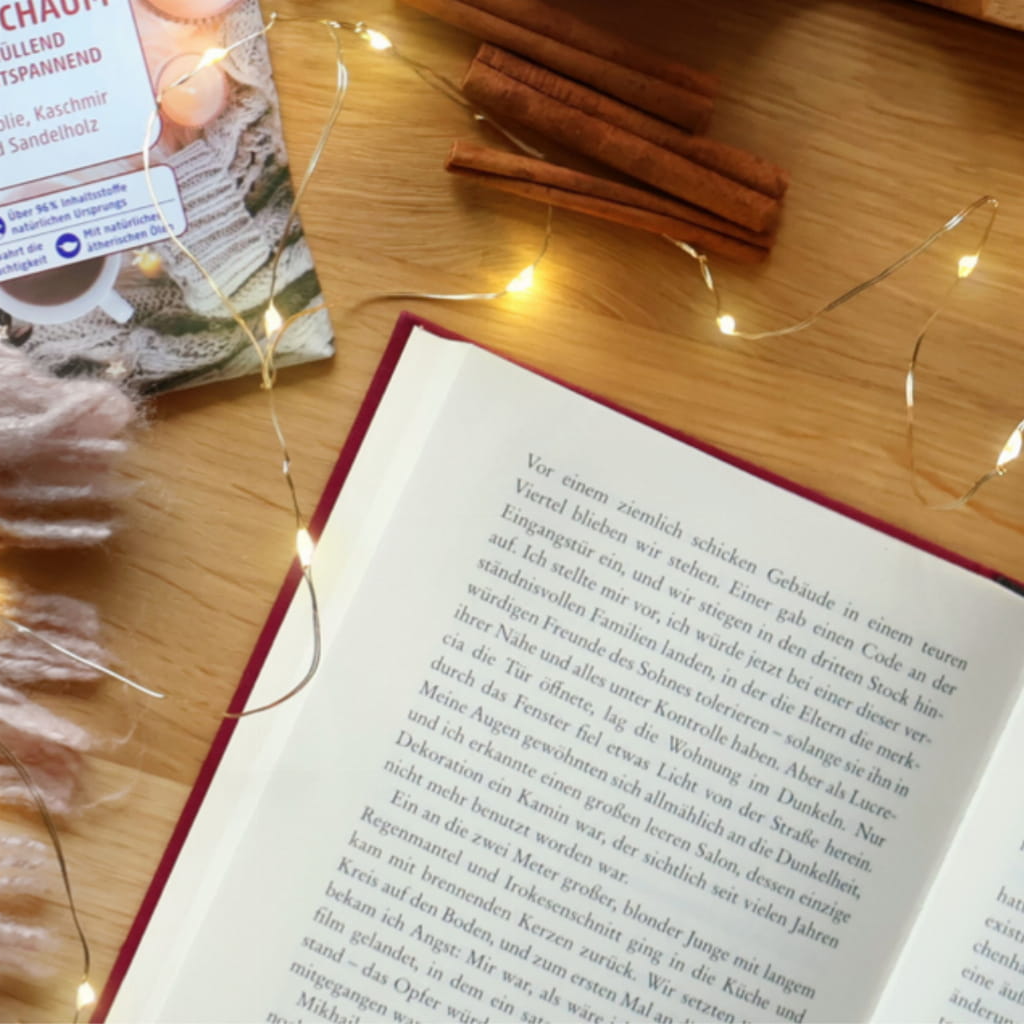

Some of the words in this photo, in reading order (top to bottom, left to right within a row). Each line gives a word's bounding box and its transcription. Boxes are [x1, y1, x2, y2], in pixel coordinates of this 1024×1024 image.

[9, 118, 100, 154] Sandelholz
[33, 90, 108, 121] Kaschmir
[8, 207, 34, 221] Über
[59, 183, 127, 207] Inhaltsstoffe
[11, 213, 72, 236] natürlichen
[73, 198, 128, 220] Ursprungs
[27, 241, 44, 255] die
[83, 226, 101, 239] Mit
[103, 213, 160, 233] natürliche
[87, 230, 148, 253] ätherischen
[487, 533, 518, 554] auf.
[521, 543, 547, 568] Ich
[550, 561, 597, 591] stellte
[599, 585, 630, 605] mir
[633, 600, 661, 624] vor,
[665, 611, 690, 635] ich
[695, 628, 745, 660] würde
[744, 649, 783, 679] jetzt
[785, 666, 813, 691] bei
[812, 684, 854, 710] einer
[854, 700, 901, 732] dieser
[904, 725, 931, 743] ver-
[500, 502, 595, 558] Eingangstür
[597, 552, 625, 577] ein,
[631, 569, 665, 591] und
[668, 585, 695, 606] wir
[697, 600, 753, 634] stiegen
[756, 623, 774, 644] in
[776, 634, 807, 659] den
[810, 649, 864, 685] dritten
[866, 675, 909, 706] Stock
[912, 694, 943, 719] hin-
[515, 477, 568, 515] Viertel
[570, 503, 628, 544] blieben
[635, 539, 663, 559] wir
[667, 555, 720, 589] stehen.
[727, 579, 773, 611] Einer
[775, 607, 807, 627] gab
[811, 621, 854, 651] einen
[860, 641, 903, 672] Code
[906, 667, 927, 683] an
[931, 673, 957, 696] der
[527, 451, 554, 478] Vor
[561, 473, 609, 504] einem
[616, 499, 683, 539] ziemlich
[689, 535, 757, 574] schicken
[765, 567, 836, 610] Gebäude
[842, 601, 859, 622] in
[866, 615, 913, 647] einem
[920, 641, 968, 671] teuren
[429, 655, 475, 687] durch
[480, 679, 507, 702] das
[512, 693, 571, 732] Fenster
[574, 722, 603, 747] fiel
[605, 743, 650, 770] etwas
[655, 761, 698, 793] Licht
[704, 787, 733, 810] von
[737, 800, 765, 824] der
[768, 814, 819, 849] Straße
[823, 837, 872, 872] herein.
[441, 632, 465, 652] cia
[470, 643, 496, 666] die
[504, 656, 533, 683] Tür
[538, 676, 595, 716] öffnete,
[602, 704, 627, 733] lag
[632, 721, 659, 744] die
[668, 734, 742, 786] Wohnung
[747, 773, 770, 796] im
[775, 786, 845, 831] Dunkeln.
[853, 821, 886, 847] Nur
[452, 603, 493, 633] ihrer
[494, 622, 538, 655] Nähe
[539, 648, 573, 671] und
[570, 662, 606, 688] alles
[608, 681, 651, 708] unter
[652, 698, 728, 745] Kontrolle
[729, 732, 779, 771] haben.
[783, 760, 824, 789] Aber
[824, 780, 846, 800] als
[847, 788, 896, 820] Lucre-
[383, 758, 423, 786] nicht
[425, 780, 468, 806] mehr
[470, 795, 531, 838] benutzt
[535, 831, 593, 867] worden
[597, 860, 628, 884] war.
[389, 788, 418, 815] Ein
[420, 809, 441, 825] an
[443, 816, 469, 839] die
[470, 832, 511, 858] zwei
[511, 846, 560, 881] Meter
[559, 876, 617, 912] großer,
[621, 898, 684, 939] blonder
[681, 929, 730, 962] Junge
[732, 955, 760, 975] mit
[761, 962, 815, 999] langem
[394, 729, 484, 784] Dekoration
[487, 777, 512, 798] ein
[515, 787, 570, 825] Kamin
[575, 819, 606, 845] war,
[611, 834, 639, 857] der
[642, 850, 707, 890] sichtlich
[711, 884, 739, 904] seit
[743, 897, 787, 927] vielen
[787, 915, 839, 949] Jahren
[406, 708, 440, 731] und
[440, 720, 465, 744] ich
[467, 739, 537, 778] erkannte
[539, 771, 582, 800] einen
[583, 795, 641, 828] großen
[643, 816, 691, 852] leeren
[694, 841, 740, 877] Salon,
[744, 865, 795, 900] dessen
[797, 891, 851, 924] einzige
[289, 961, 388, 1016] mitgegangen
[312, 906, 345, 934] film
[425, 960, 444, 981] in
[448, 972, 484, 1000] dem
[489, 994, 515, 1015] ein
[359, 805, 463, 866] Regenmantel
[466, 860, 500, 883] und
[503, 874, 622, 943] Irokesenschnitt
[625, 937, 663, 966] ging
[667, 951, 685, 972] in
[690, 963, 716, 986] die
[721, 975, 770, 1010] Küche
[775, 1004, 807, 1019] und
[961, 965, 995, 990] eine
